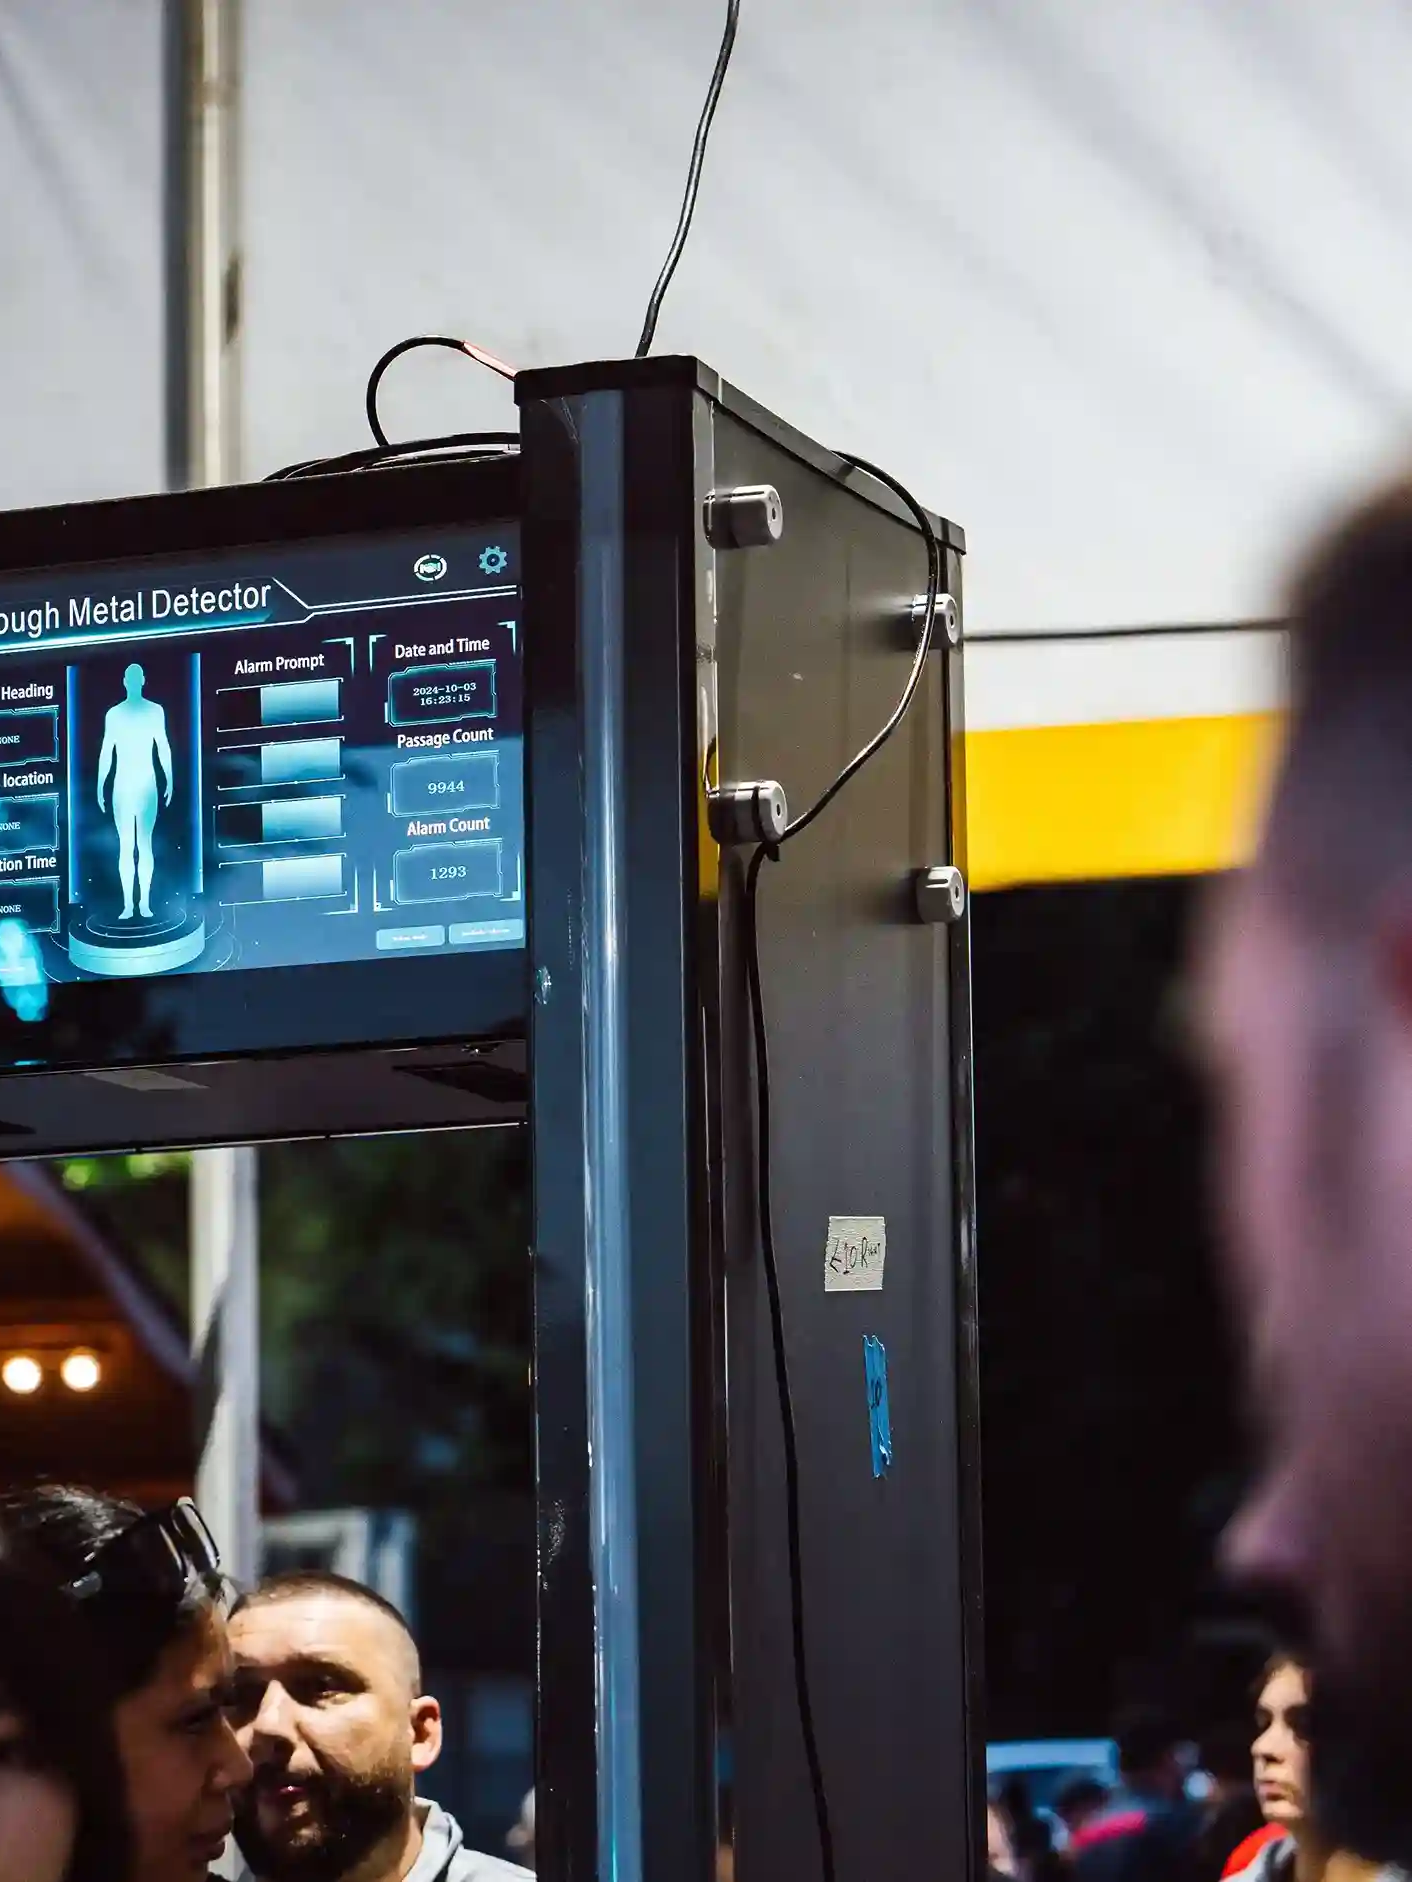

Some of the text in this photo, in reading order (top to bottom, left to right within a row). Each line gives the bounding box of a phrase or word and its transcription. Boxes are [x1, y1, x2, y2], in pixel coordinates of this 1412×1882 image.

[69, 591, 142, 627] Metal
[152, 582, 271, 619] Detector
[395, 638, 490, 659] Date and Time
[234, 653, 325, 675] Alarm Prompt
[1, 683, 53, 700] Heading
[413, 682, 477, 696] 2024-10-03
[420, 693, 471, 706] 16:23:15
[397, 727, 494, 748] Passage Count
[3, 771, 53, 788] location
[427, 780, 465, 794] 9944
[407, 816, 491, 836] Alarm Count
[25, 855, 57, 870] Time
[429, 866, 467, 880] 1293
